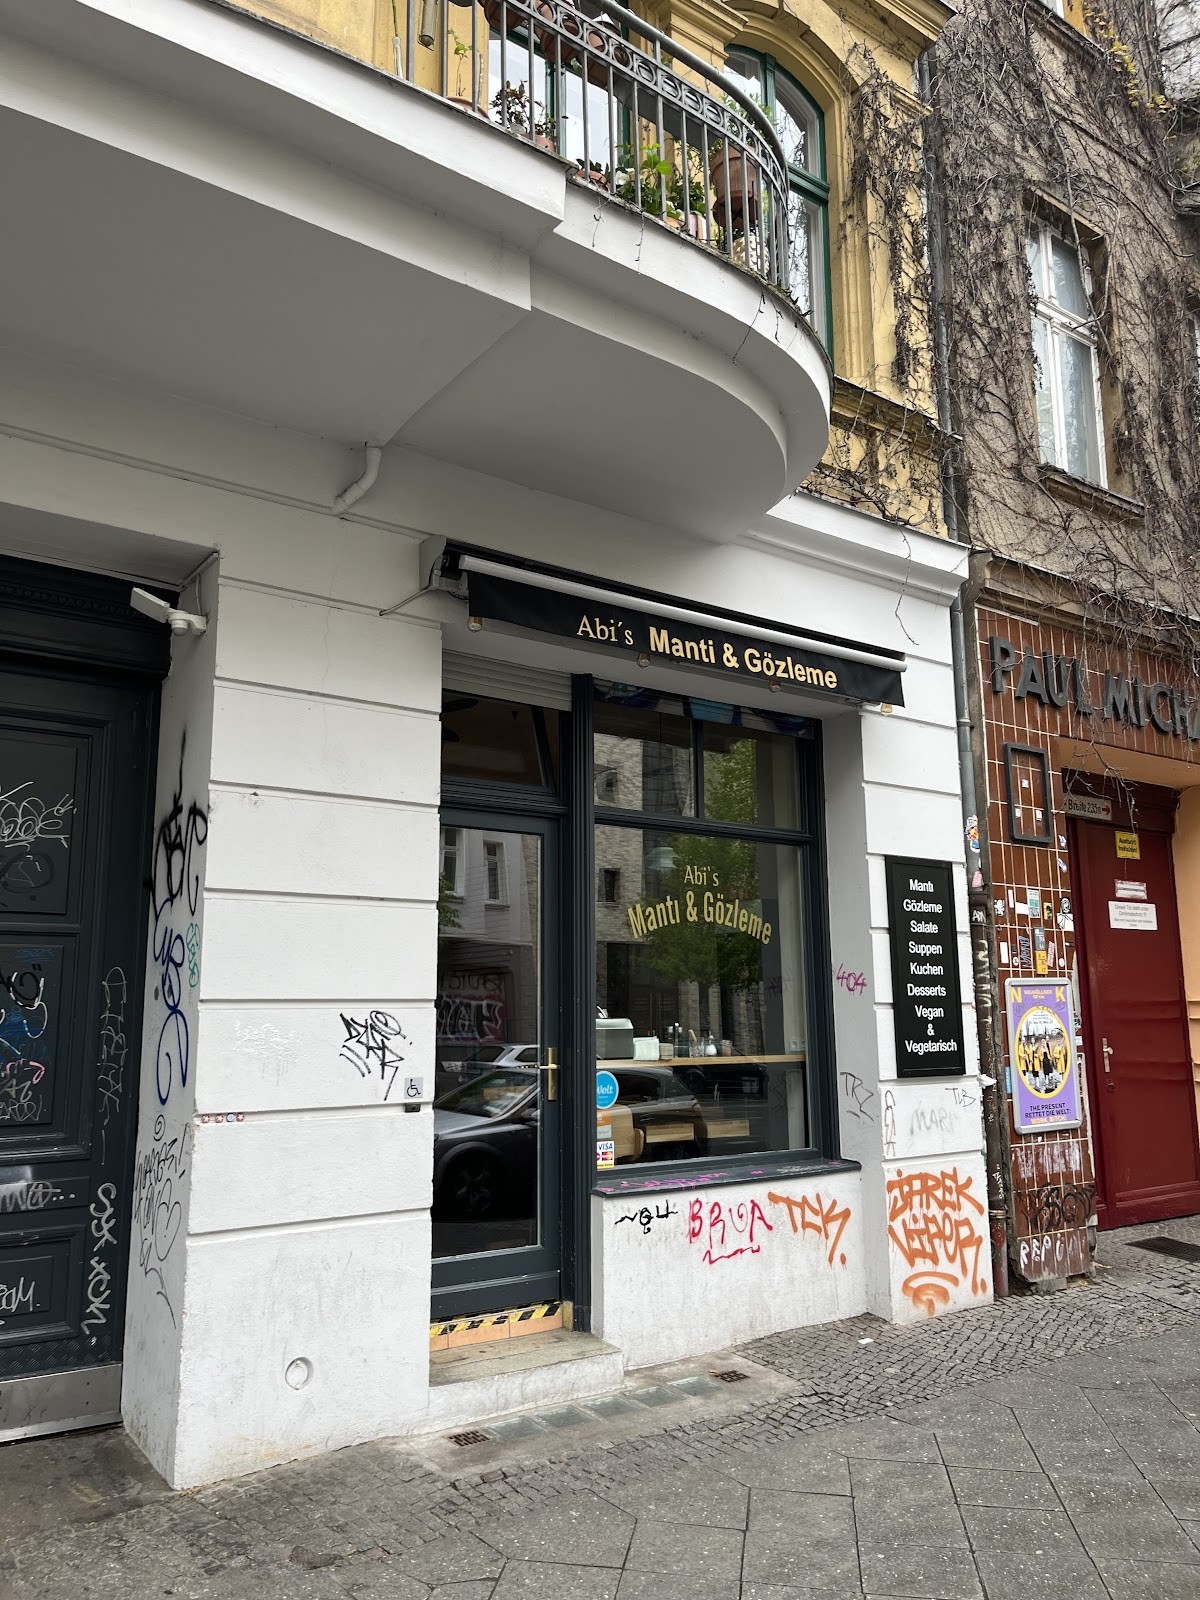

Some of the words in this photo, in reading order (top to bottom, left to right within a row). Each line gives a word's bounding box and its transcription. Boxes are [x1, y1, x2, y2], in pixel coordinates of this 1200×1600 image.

[649, 625, 716, 664] Manti
[722, 642, 740, 669] &
[743, 647, 838, 690] Gözleme
[989, 635, 1093, 716] PAUL
[903, 898, 943, 914] Gözleme
[686, 890, 698, 922] &
[703, 891, 772, 945] Gözleme
[910, 920, 938, 934] Salate
[908, 941, 942, 957] Suppen
[909, 962, 944, 976] Kuchen
[907, 983, 946, 997] Desserts
[1011, 986, 1022, 1003] N
[1055, 986, 1066, 1002] K
[915, 1005, 944, 1020] Vegan
[926, 1023, 935, 1036] &
[905, 1039, 958, 1055] Vegetarisch
[598, 1142, 613, 1150] VISA
